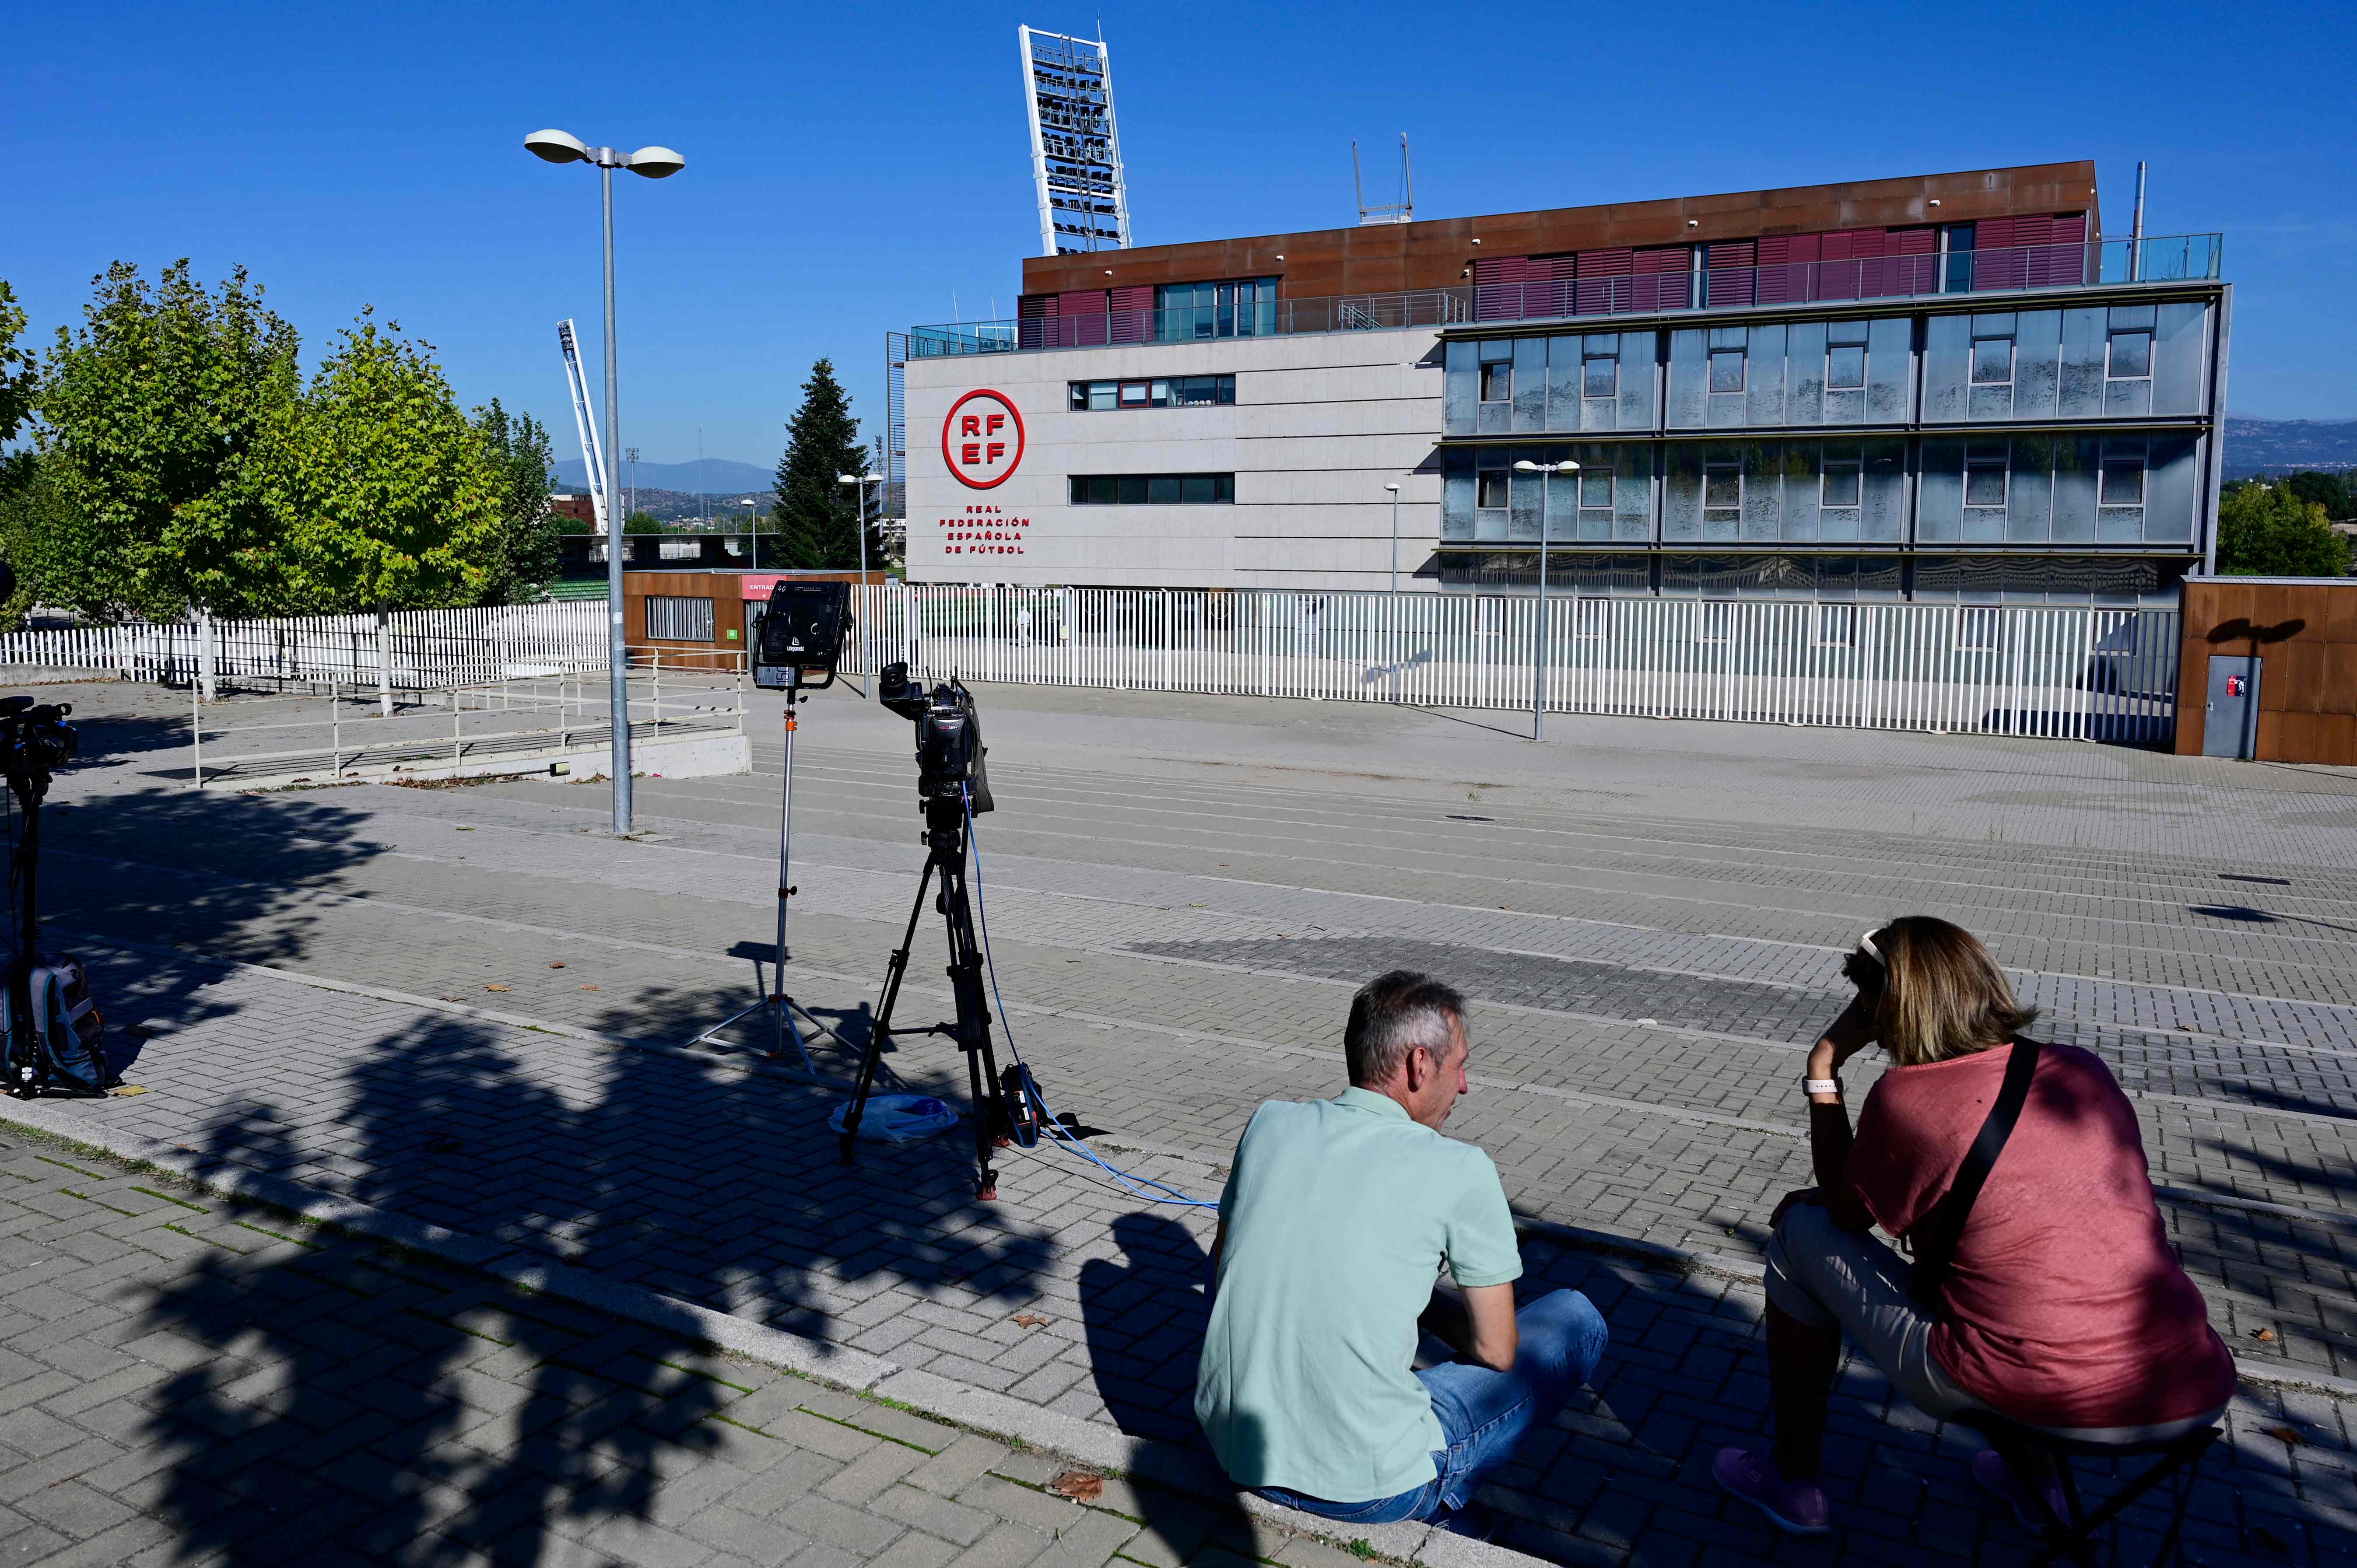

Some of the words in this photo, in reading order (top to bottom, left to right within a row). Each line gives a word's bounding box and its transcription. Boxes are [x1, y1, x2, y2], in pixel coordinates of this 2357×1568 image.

[940, 517, 1029, 526] FEDERACIÓN
[947, 531, 1021, 540] ESPAÑOLA
[945, 546, 961, 554] DE
[970, 544, 1024, 554] FÚTBOL
